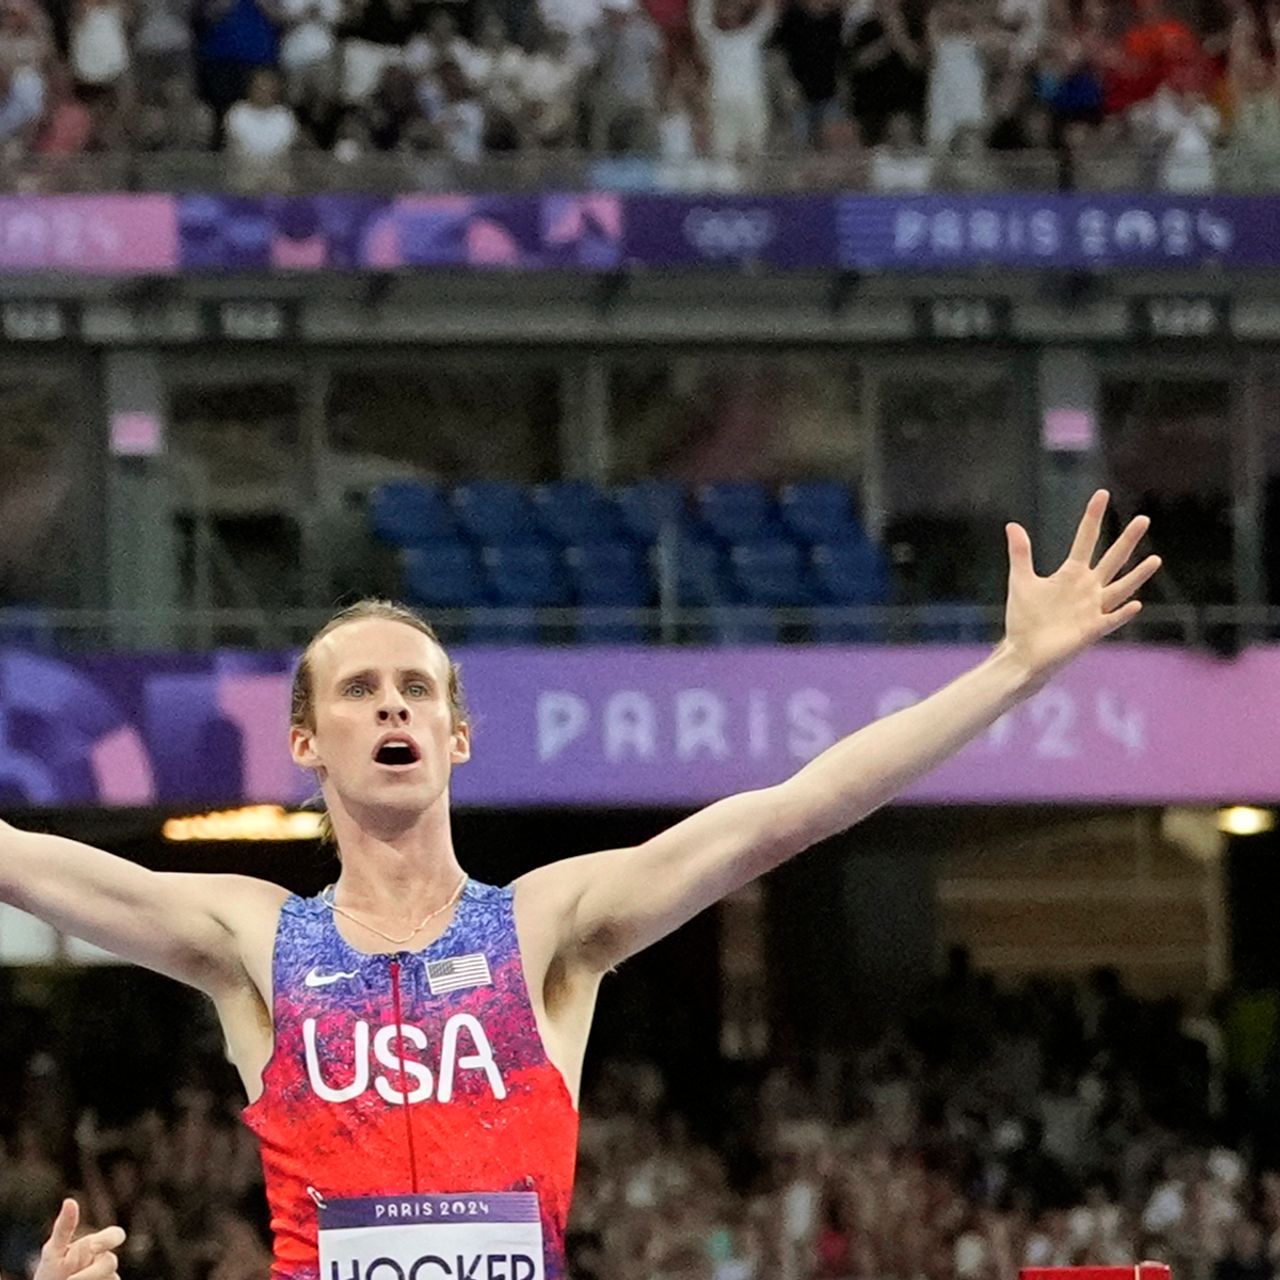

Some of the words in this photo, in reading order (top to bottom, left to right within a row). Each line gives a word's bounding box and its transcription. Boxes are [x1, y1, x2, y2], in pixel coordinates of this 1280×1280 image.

[537, 686, 834, 762] PARIS
[302, 1013, 507, 1104] USA
[376, 1203, 433, 1218] PARIS
[440, 1201, 490, 1216] 2024
